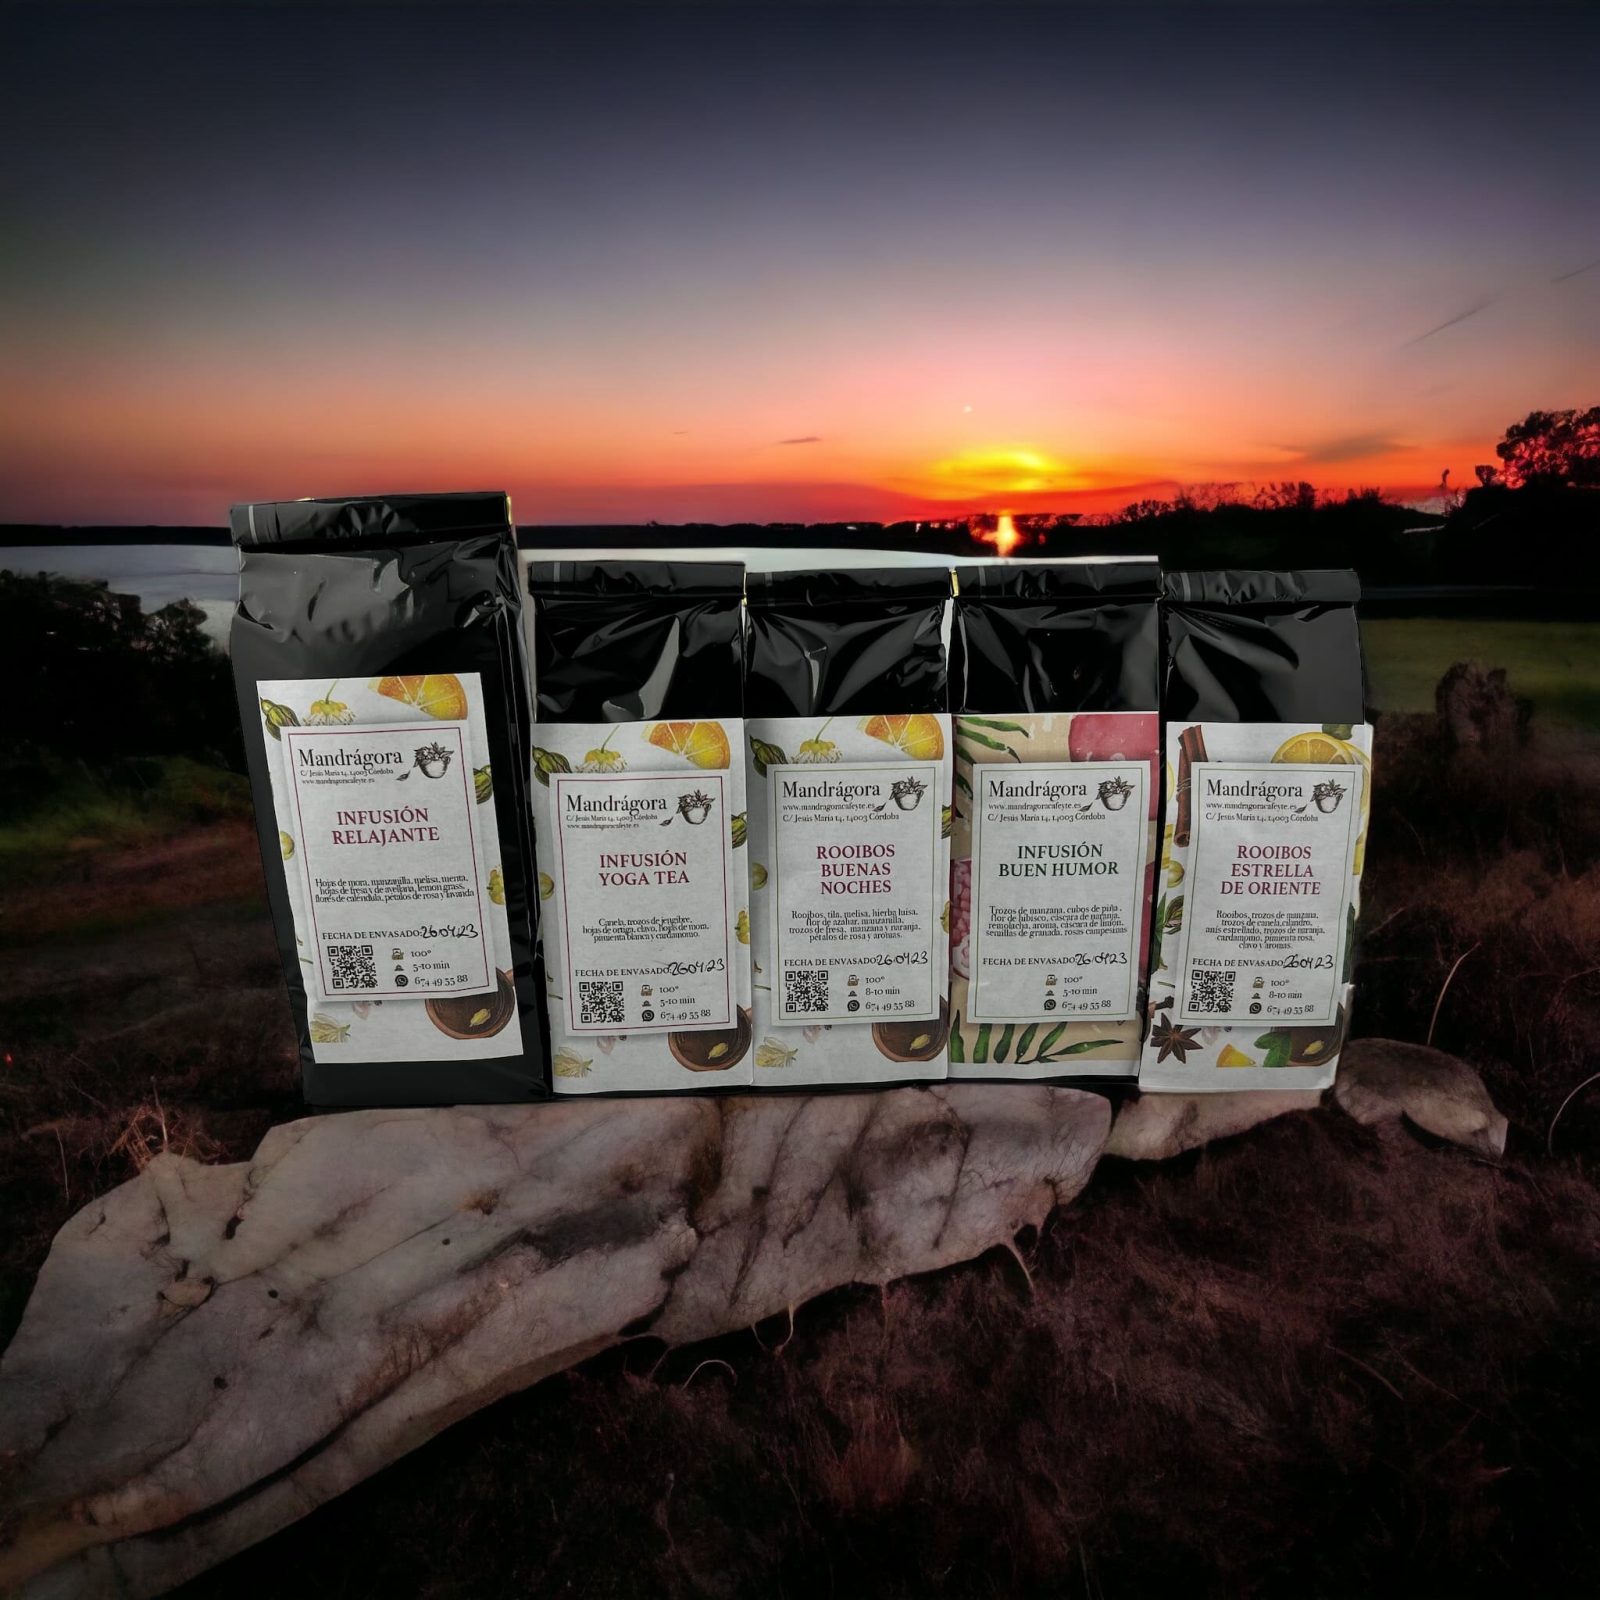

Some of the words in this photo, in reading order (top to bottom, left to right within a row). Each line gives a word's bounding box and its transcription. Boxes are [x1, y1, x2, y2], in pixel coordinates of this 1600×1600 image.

[298, 748, 404, 772] Mandrágora
[782, 780, 881, 802] Mandrágora
[989, 779, 1087, 801] Mandrágora
[1207, 778, 1303, 802] Mandrágora
[566, 794, 668, 816] Mandrágora
[336, 806, 429, 825] INFUSIÓN
[868, 812, 900, 821] Córdoba
[1075, 812, 1106, 820] Córdoba
[332, 827, 440, 847] RELAJANTE
[816, 844, 895, 860] ROOIBOS
[1017, 841, 1103, 859] INFUSIÓN
[1237, 845, 1312, 859] ROOIBOS
[600, 850, 687, 868] INFUSIÓN
[821, 862, 891, 878] BUENAS
[999, 863, 1048, 877] BUEN
[1052, 861, 1119, 877] HUMOR
[1231, 863, 1314, 878] ESTRELLA
[598, 871, 650, 886] YOGA
[654, 870, 690, 885] TEA
[820, 880, 892, 895] NOCHES
[1220, 881, 1243, 895] DE
[1248, 881, 1321, 895] ORIENTE
[872, 908, 896, 917] hierba
[989, 905, 1017, 915] Trozos
[1018, 906, 1028, 915] de
[1067, 905, 1089, 914] cubos
[1091, 905, 1101, 913] de
[822, 918, 831, 927] de
[1007, 914, 1017, 922] de
[1079, 913, 1089, 921] de
[789, 926, 814, 934] trozos
[815, 925, 824, 934] de
[1018, 928, 1028, 936] de
[322, 932, 352, 940] FECHA
[838, 933, 848, 941] de
[413, 963, 432, 973] 5-10
[433, 961, 451, 969] min
[784, 959, 813, 967] FECHA
[982, 958, 1012, 966] FECHA
[1014, 957, 1026, 965] DE
[1192, 958, 1222, 967] FECHA
[1224, 959, 1236, 967] DE
[575, 969, 604, 977] FECHA
[607, 969, 620, 977] DE
[865, 988, 884, 996] 8-10
[885, 986, 900, 995] min
[1063, 989, 1080, 998] 5-10
[1082, 987, 1098, 995] min
[1268, 991, 1286, 999] 8-10
[1287, 990, 1302, 999] min
[660, 999, 678, 1007] 5-10
[679, 996, 696, 1005] min
